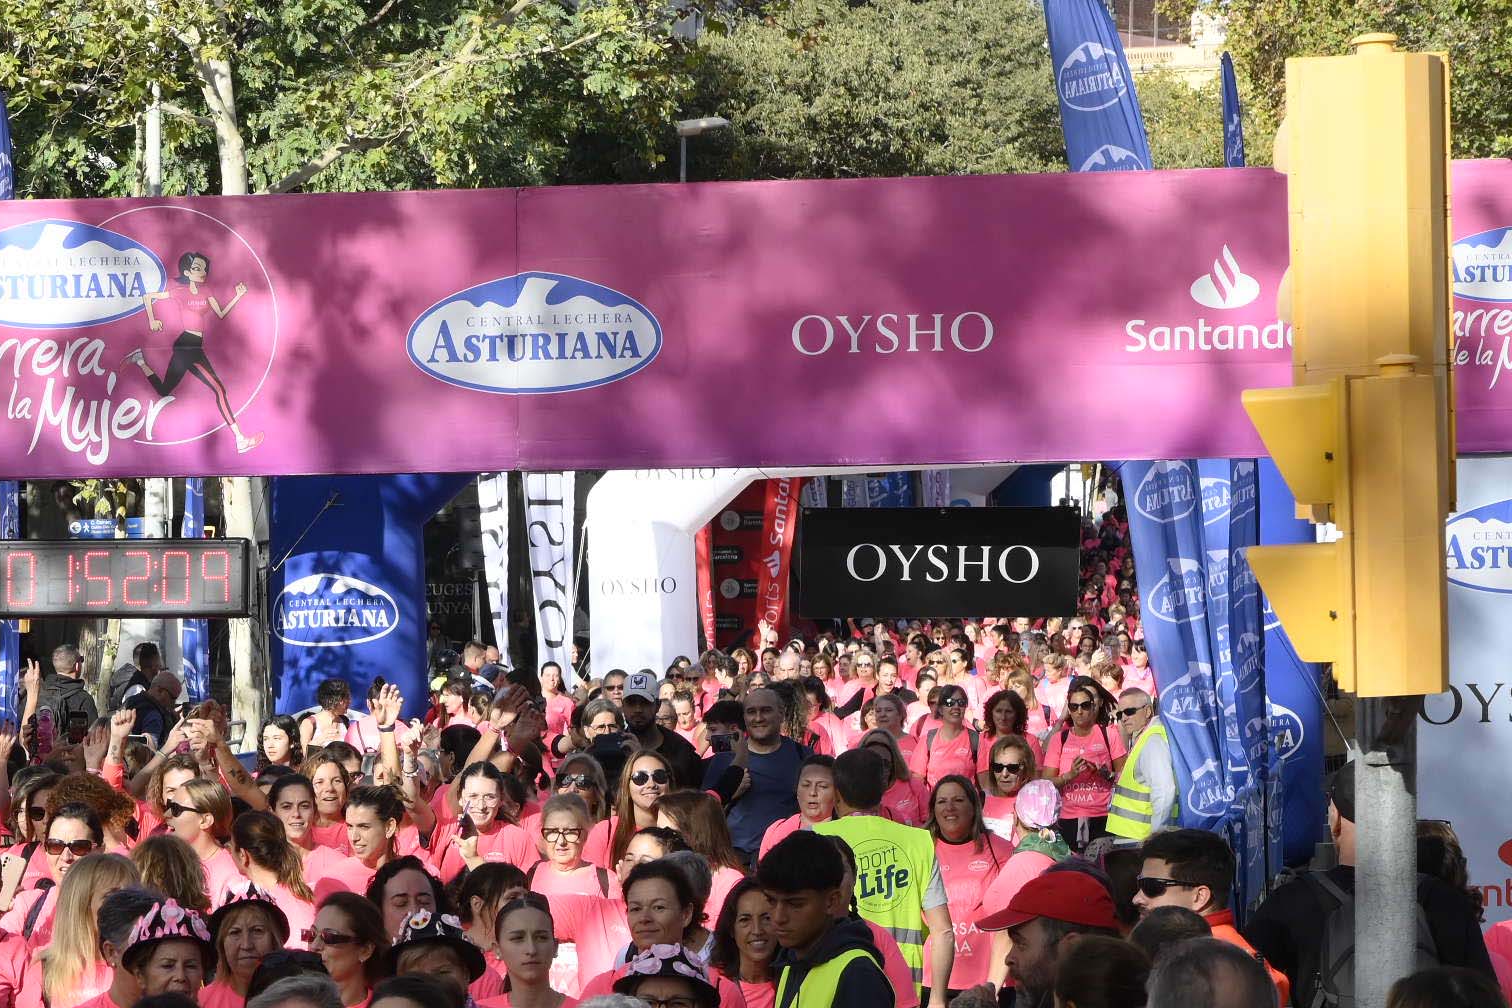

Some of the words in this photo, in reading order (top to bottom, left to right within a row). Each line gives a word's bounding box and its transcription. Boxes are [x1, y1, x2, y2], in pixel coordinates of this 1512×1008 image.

[466, 314, 545, 327] CENTRAL
[553, 312, 634, 325] LECHERA
[791, 311, 994, 356] OYSHO
[427, 319, 642, 363] ASTURIANA
[1475, 338, 1493, 365] la
[7, 379, 32, 420] la
[27, 371, 177, 466] Mujer
[846, 543, 1040, 584] OYSHO
[601, 576, 678, 595] OYSHO
[289, 598, 327, 608] CENTRAL
[331, 597, 385, 608] LECHERA
[278, 608, 390, 632] ASTURIANA
[1418, 683, 1512, 726] OY
[1065, 792, 1094, 802] SUMA
[859, 864, 909, 900] Life
